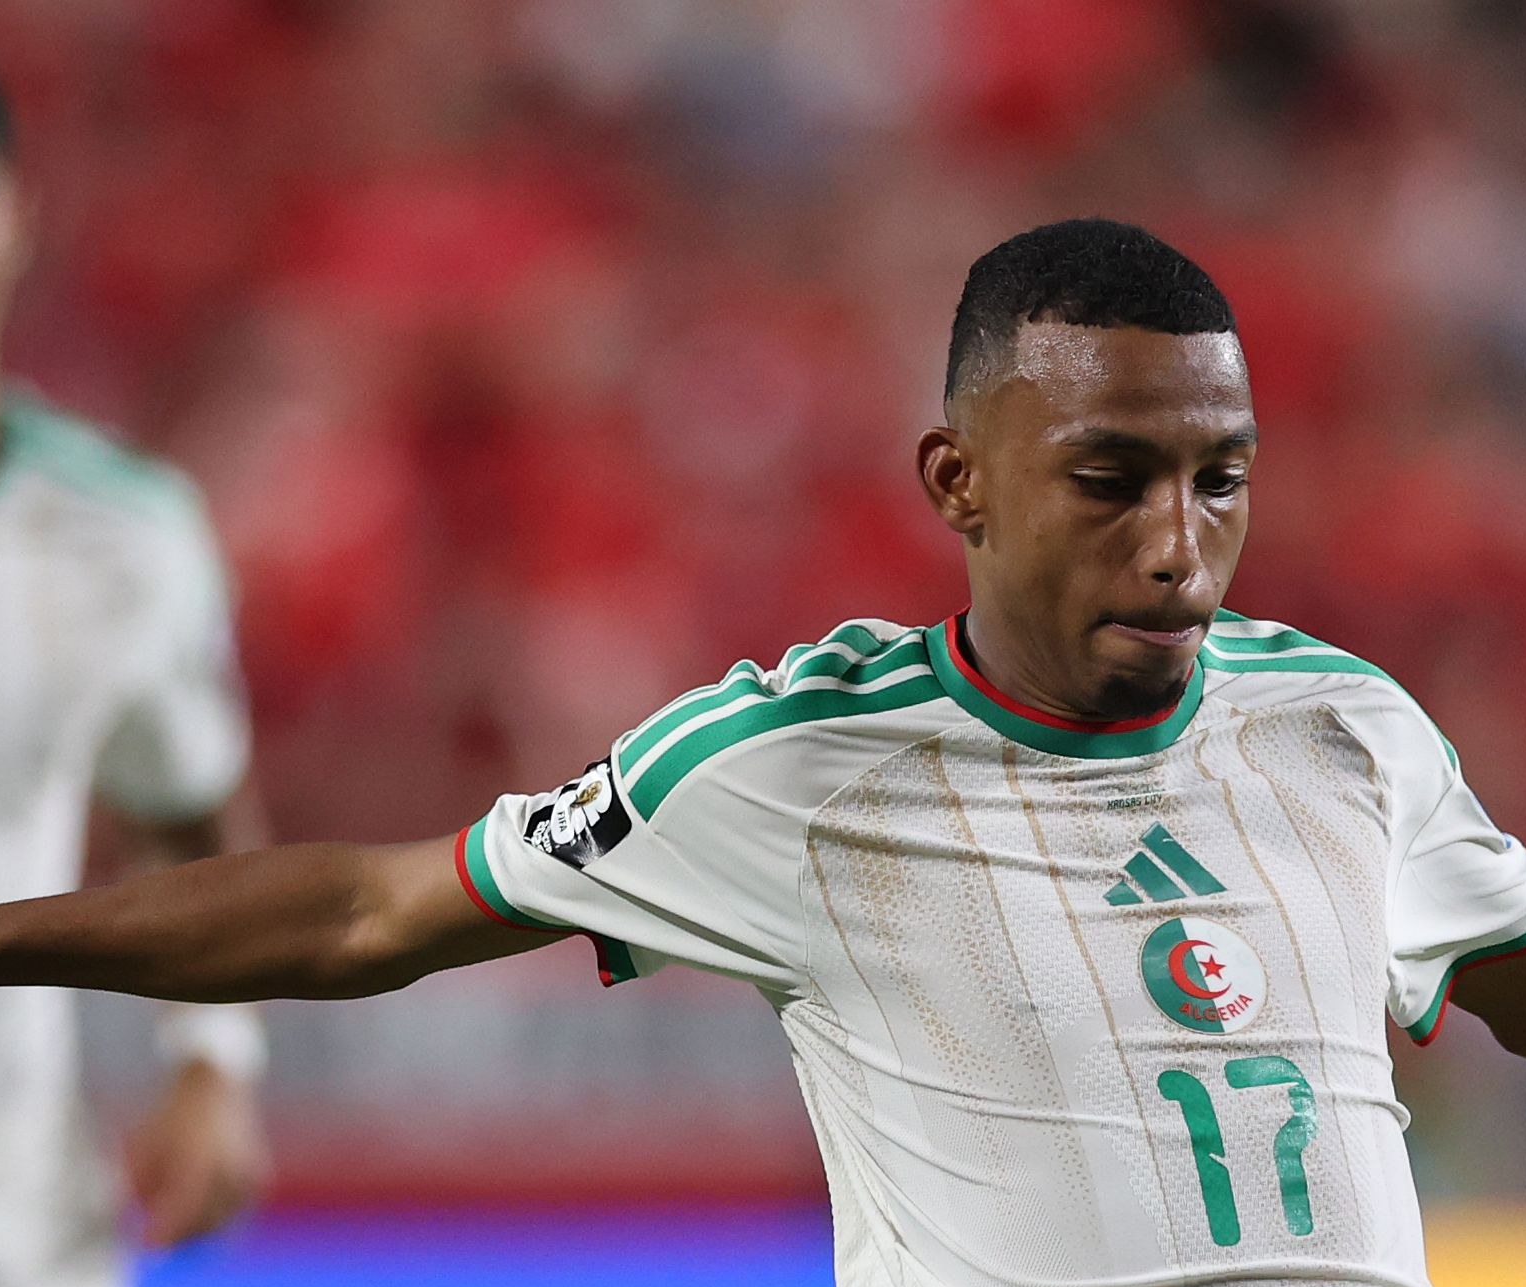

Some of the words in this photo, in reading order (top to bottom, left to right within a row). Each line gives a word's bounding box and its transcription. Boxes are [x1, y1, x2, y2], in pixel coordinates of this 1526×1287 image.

[557, 811, 568, 832] FIFA
[1179, 993, 1253, 1022] ALGERIA
[1157, 1055, 1317, 1247] 17
